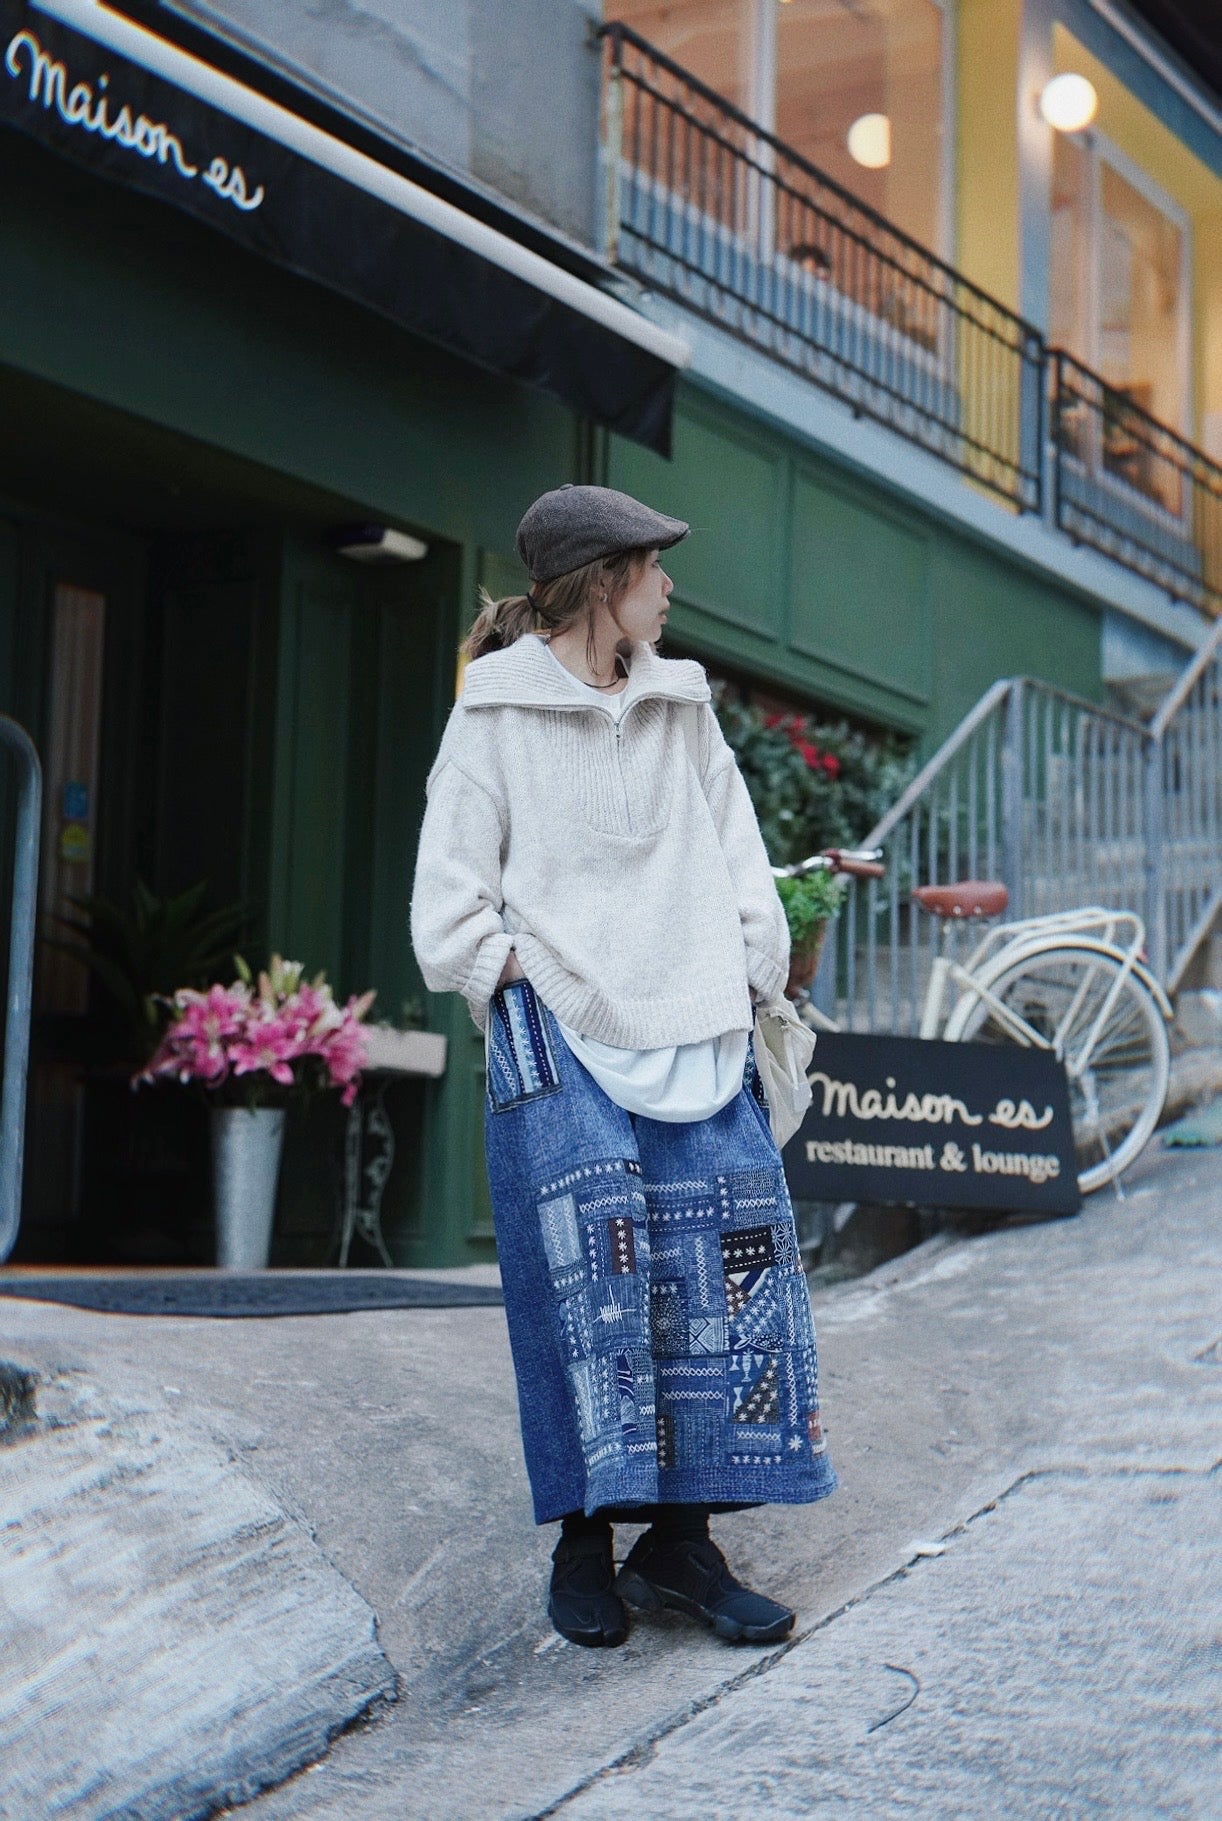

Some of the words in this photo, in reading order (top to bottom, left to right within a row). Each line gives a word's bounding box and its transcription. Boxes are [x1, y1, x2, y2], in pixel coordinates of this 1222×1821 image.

[6, 29, 198, 178] Maison
[202, 157, 265, 211] es
[808, 1071, 982, 1125] Maison
[988, 1099, 1054, 1130] es
[805, 1139, 935, 1170] restaurant
[939, 1141, 968, 1172] &
[973, 1143, 1061, 1184] lounge
